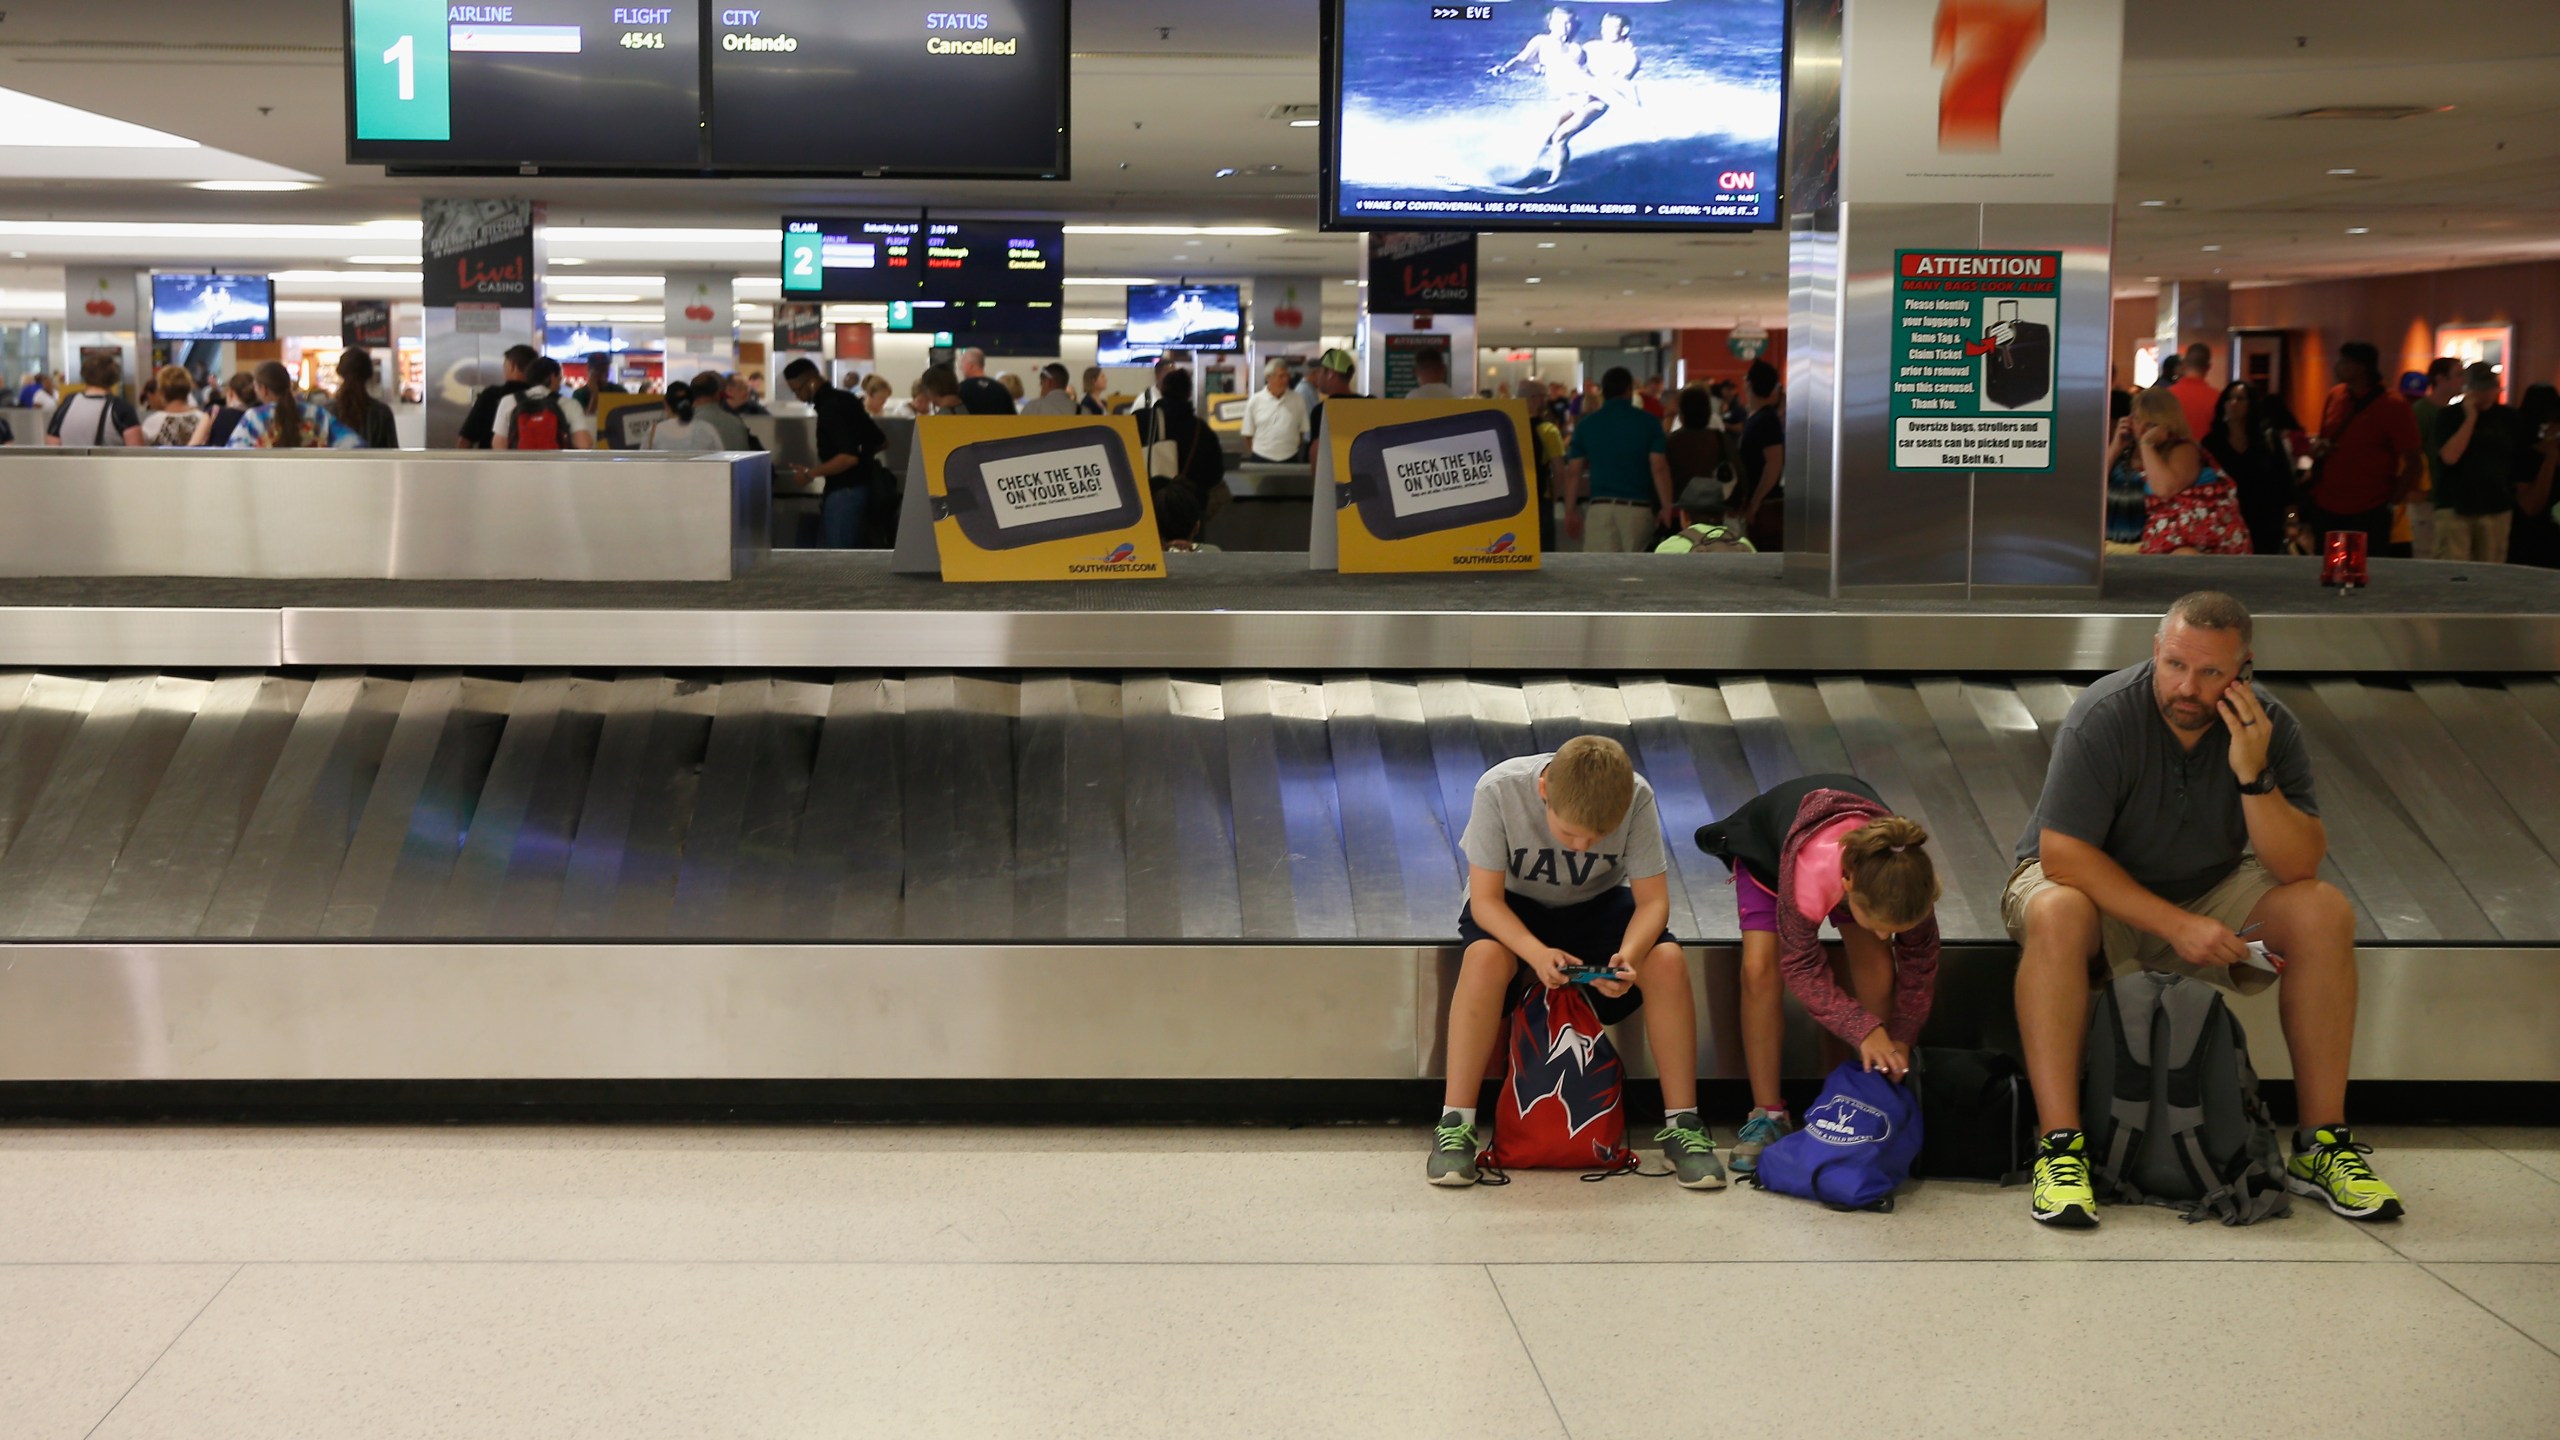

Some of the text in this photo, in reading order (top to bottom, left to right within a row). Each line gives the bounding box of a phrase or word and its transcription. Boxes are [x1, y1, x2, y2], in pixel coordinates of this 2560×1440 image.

[448, 5, 513, 23] AIRLINE
[613, 8, 672, 25] FLIGHT
[722, 9, 761, 27] CITY
[1465, 6, 1491, 19] EVE
[926, 13, 989, 30] STATUS
[619, 31, 665, 50] 4541
[722, 33, 798, 53] Orlando
[926, 36, 1017, 56] Cancelled
[383, 34, 415, 101] 1
[1717, 171, 1755, 191] CNN
[1364, 201, 1391, 211] WAKE
[1393, 201, 1407, 211] OF
[1407, 201, 1484, 212] CONTROVERSIAL
[1485, 202, 1504, 212] USE
[1505, 203, 1519, 213] OF
[1520, 203, 1569, 213] PERSONAL
[1569, 204, 1599, 214] EMAIL
[1600, 204, 1636, 215] SERVER
[1658, 205, 1701, 216] CLINTON:
[1711, 205, 1737, 216] LOVE
[789, 222, 819, 233] CLAIM
[793, 246, 814, 276] 2
[1916, 256, 2042, 276] ATTENTION
[458, 255, 524, 290] Live!
[1404, 263, 1469, 296] Live!
[477, 281, 524, 293] CASINO
[1902, 280, 2054, 293] MANY BAGS LOOK ALIKE
[1422, 288, 1468, 300] CASINO
[1904, 298, 1935, 311] Please
[1902, 316, 1971, 329] your luggage by
[1911, 332, 1961, 345] Name Tag &
[1909, 349, 1963, 361] Claim Ticket
[1900, 366, 1970, 377] prior to removal
[1894, 382, 1976, 393] from this carousel.
[1911, 398, 1958, 410] Thank You.
[1908, 421, 1949, 432] Oversize
[1977, 421, 2018, 432] strollers
[2020, 421, 2038, 432] and
[1898, 438, 2048, 451] car seats can be picked up near
[1397, 449, 1493, 479] CHECK THE TAG
[1942, 453, 2005, 466] Bag Belt No. 1
[997, 463, 1102, 492] CHECK THE TAG
[1404, 476, 1423, 493] ON
[1425, 471, 1460, 489] YOUR
[1463, 464, 1493, 483] BAG!
[1006, 489, 1027, 506] ON
[1028, 483, 1067, 501] YOUR
[1069, 478, 1103, 496] BAG!
[1452, 554, 1532, 565] SOUTHWEST.COM
[1068, 562, 1157, 574] SOUTHWEST.COM
